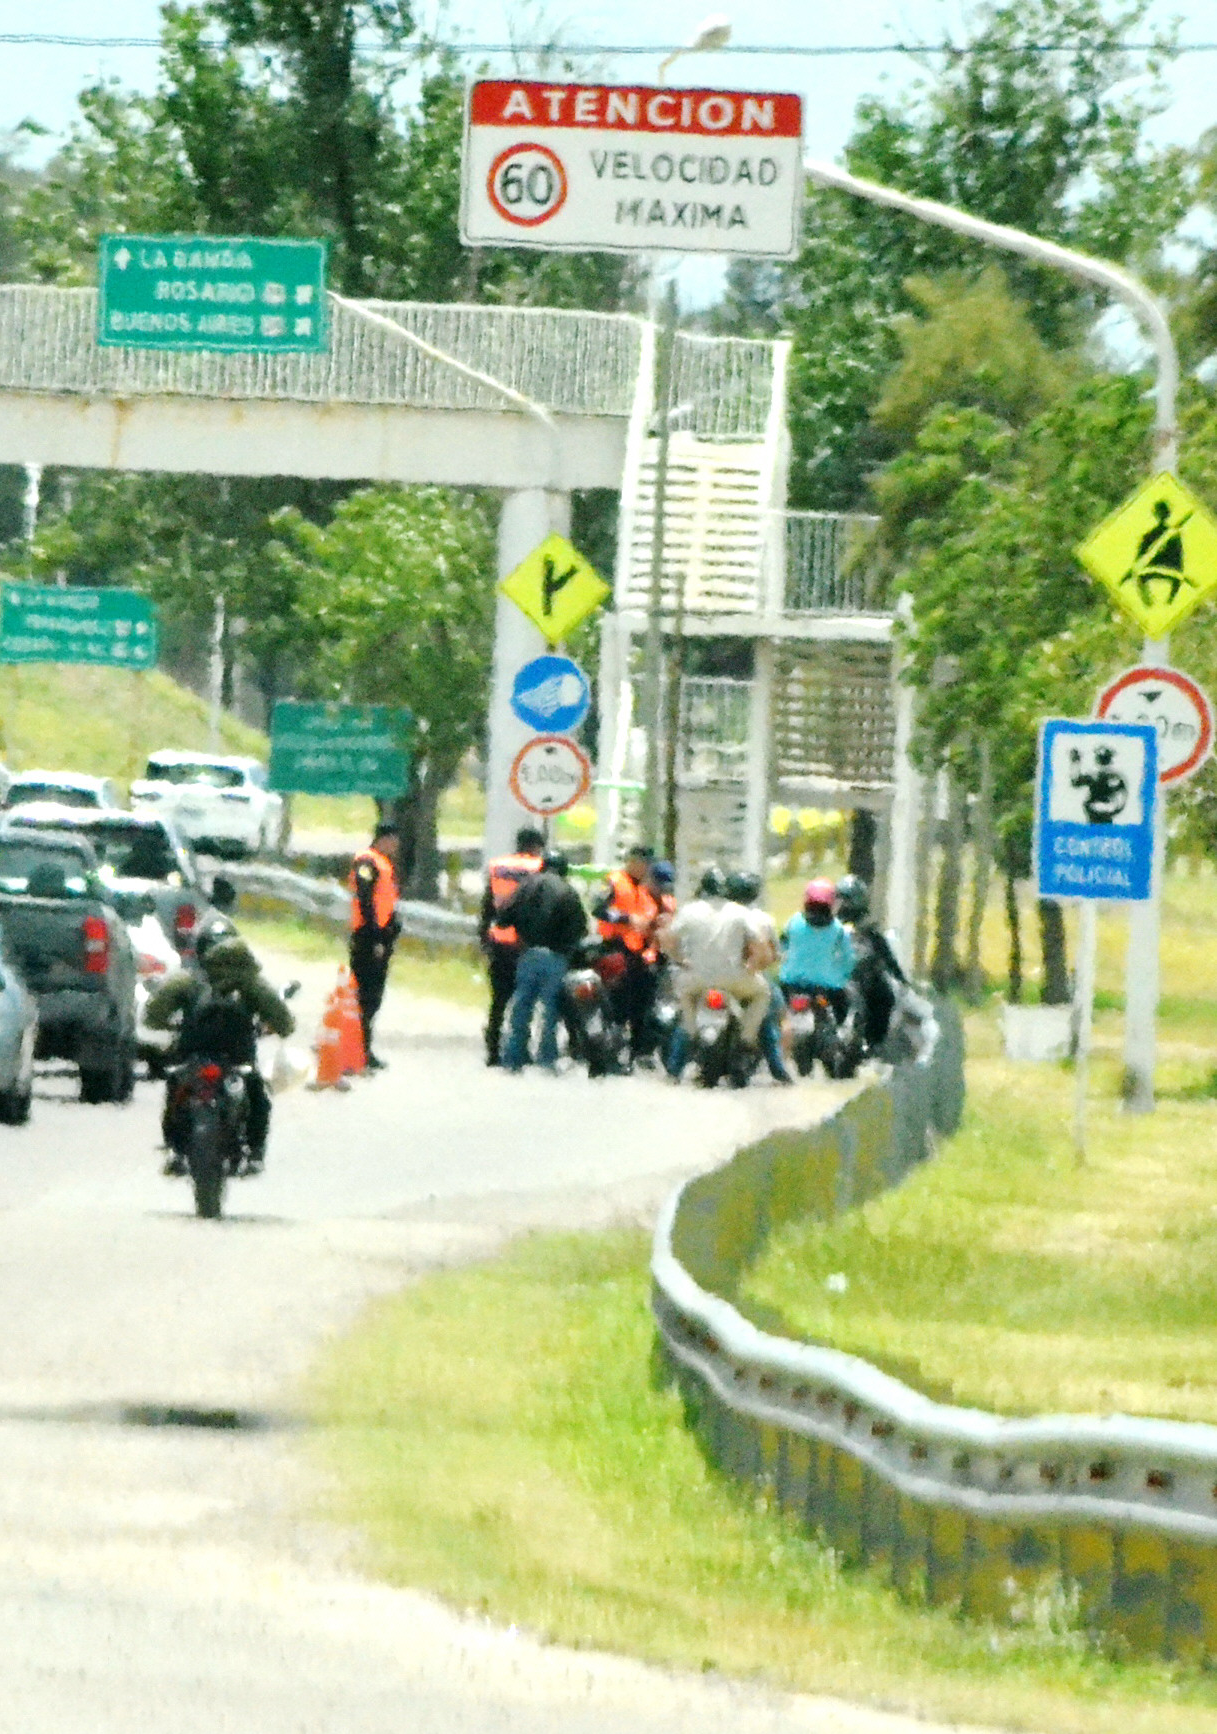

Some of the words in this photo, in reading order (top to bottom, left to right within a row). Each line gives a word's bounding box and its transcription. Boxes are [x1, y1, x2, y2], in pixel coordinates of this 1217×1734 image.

[501, 88, 776, 131] ATENCION
[499, 162, 554, 206] 60
[590, 149, 779, 186] VELOCIDAD
[615, 196, 749, 230] MAXIMA
[154, 279, 256, 304] ROSARIO
